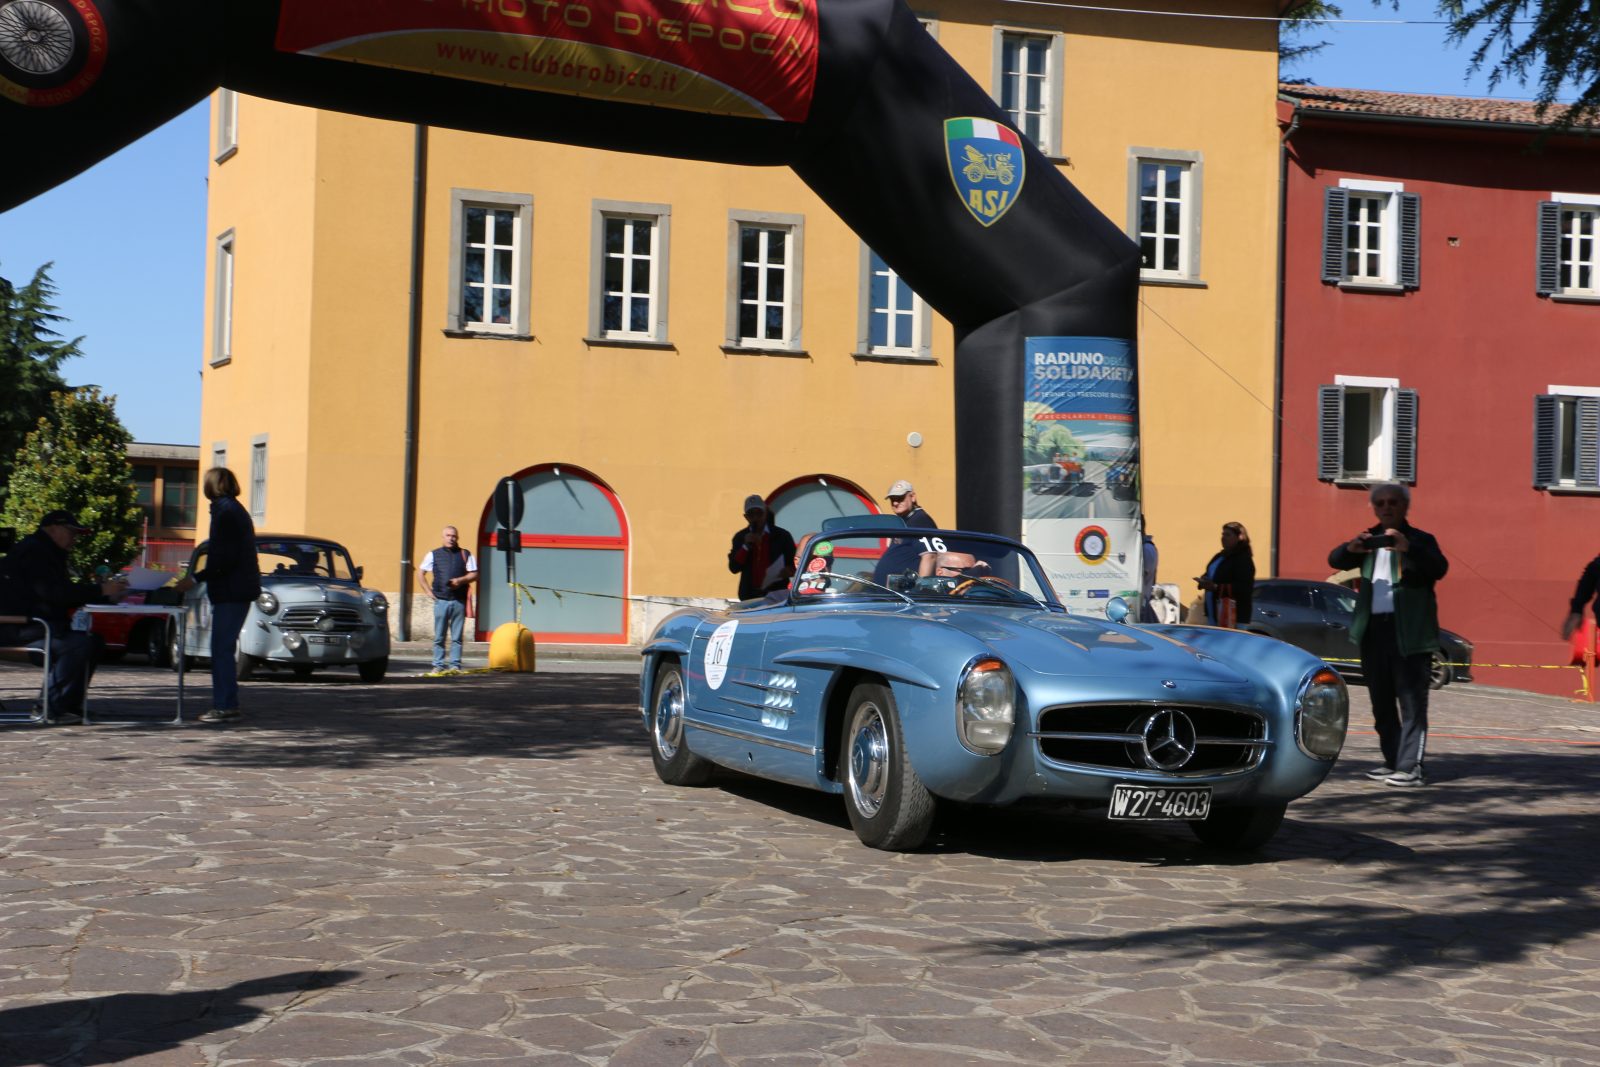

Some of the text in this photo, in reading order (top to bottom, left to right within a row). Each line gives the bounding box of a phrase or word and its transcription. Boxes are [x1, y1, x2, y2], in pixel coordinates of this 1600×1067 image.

[614, 11, 803, 57] D'EPOCA
[436, 43, 677, 92] www.cluborobico.it
[969, 189, 1009, 217] ASI
[1034, 352, 1104, 365] RADUNO
[919, 536, 948, 553] 16
[712, 638, 727, 665] 16
